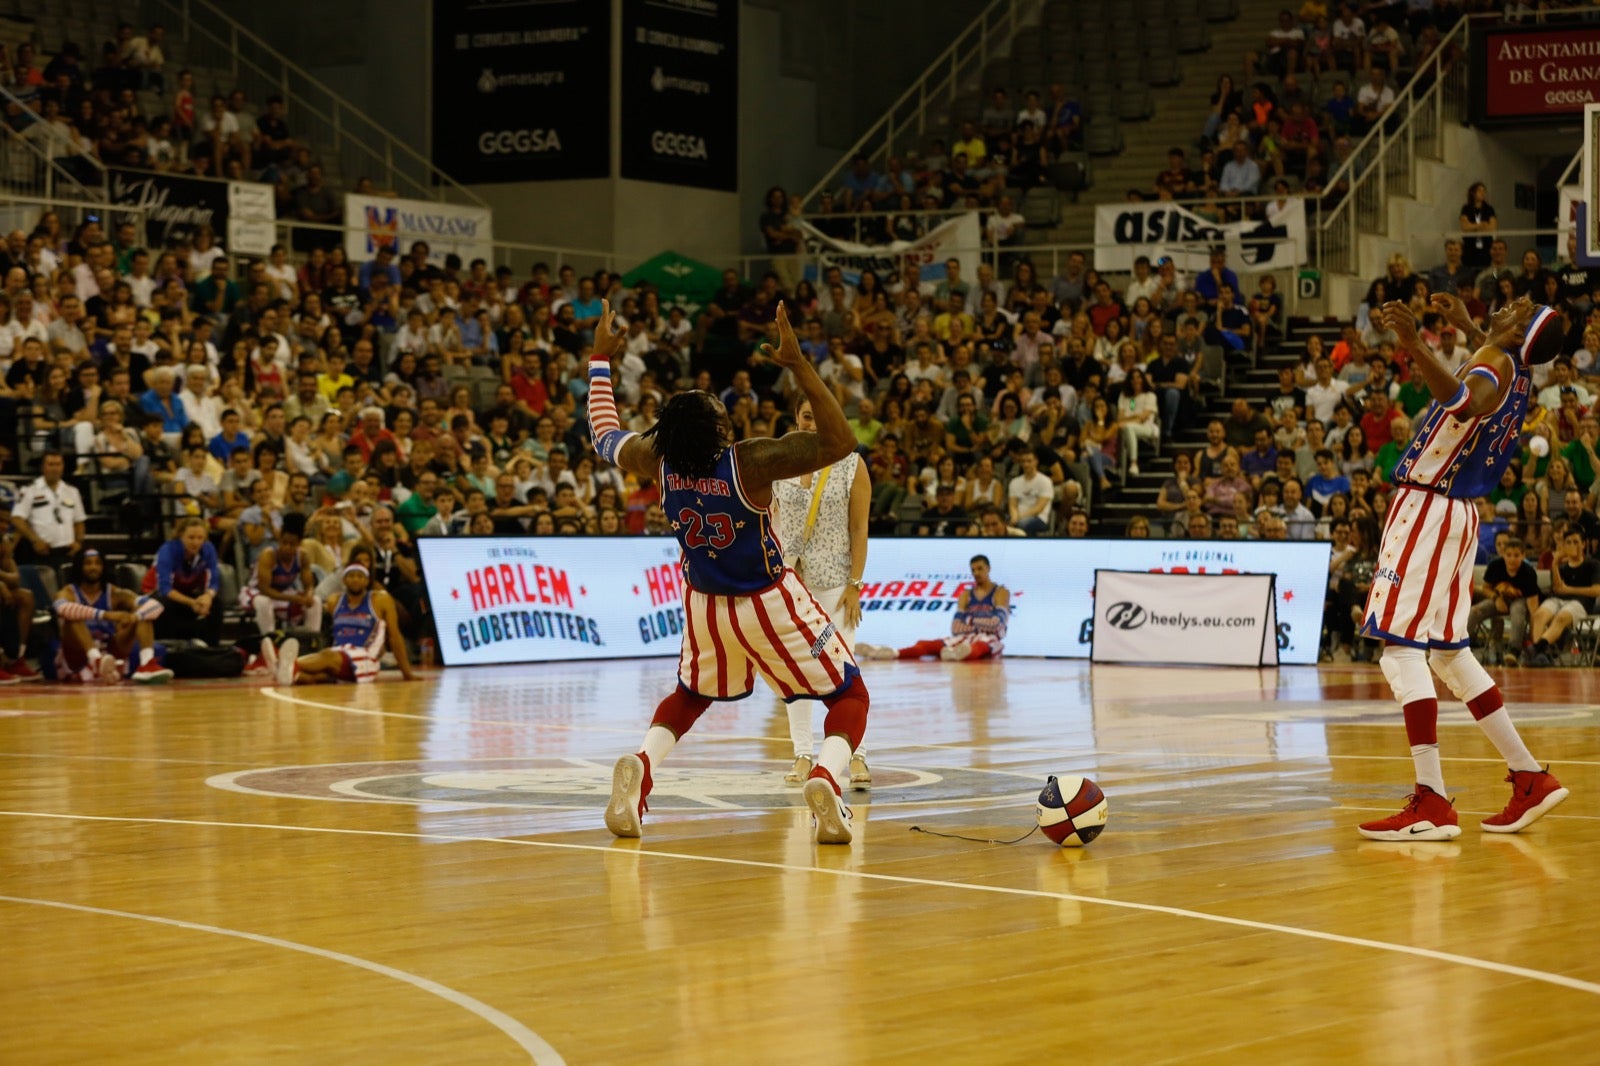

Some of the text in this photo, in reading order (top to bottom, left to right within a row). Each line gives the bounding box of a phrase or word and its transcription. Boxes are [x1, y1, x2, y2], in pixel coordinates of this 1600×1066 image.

[402, 212, 477, 237] MANZANO
[1301, 278, 1315, 298] D
[667, 473, 731, 497] THUNDER
[679, 508, 736, 549] 23
[1161, 550, 1235, 563] THE ORIGINAL
[466, 563, 574, 611] HARLEM
[1150, 611, 1256, 630] heelys.eu.com
